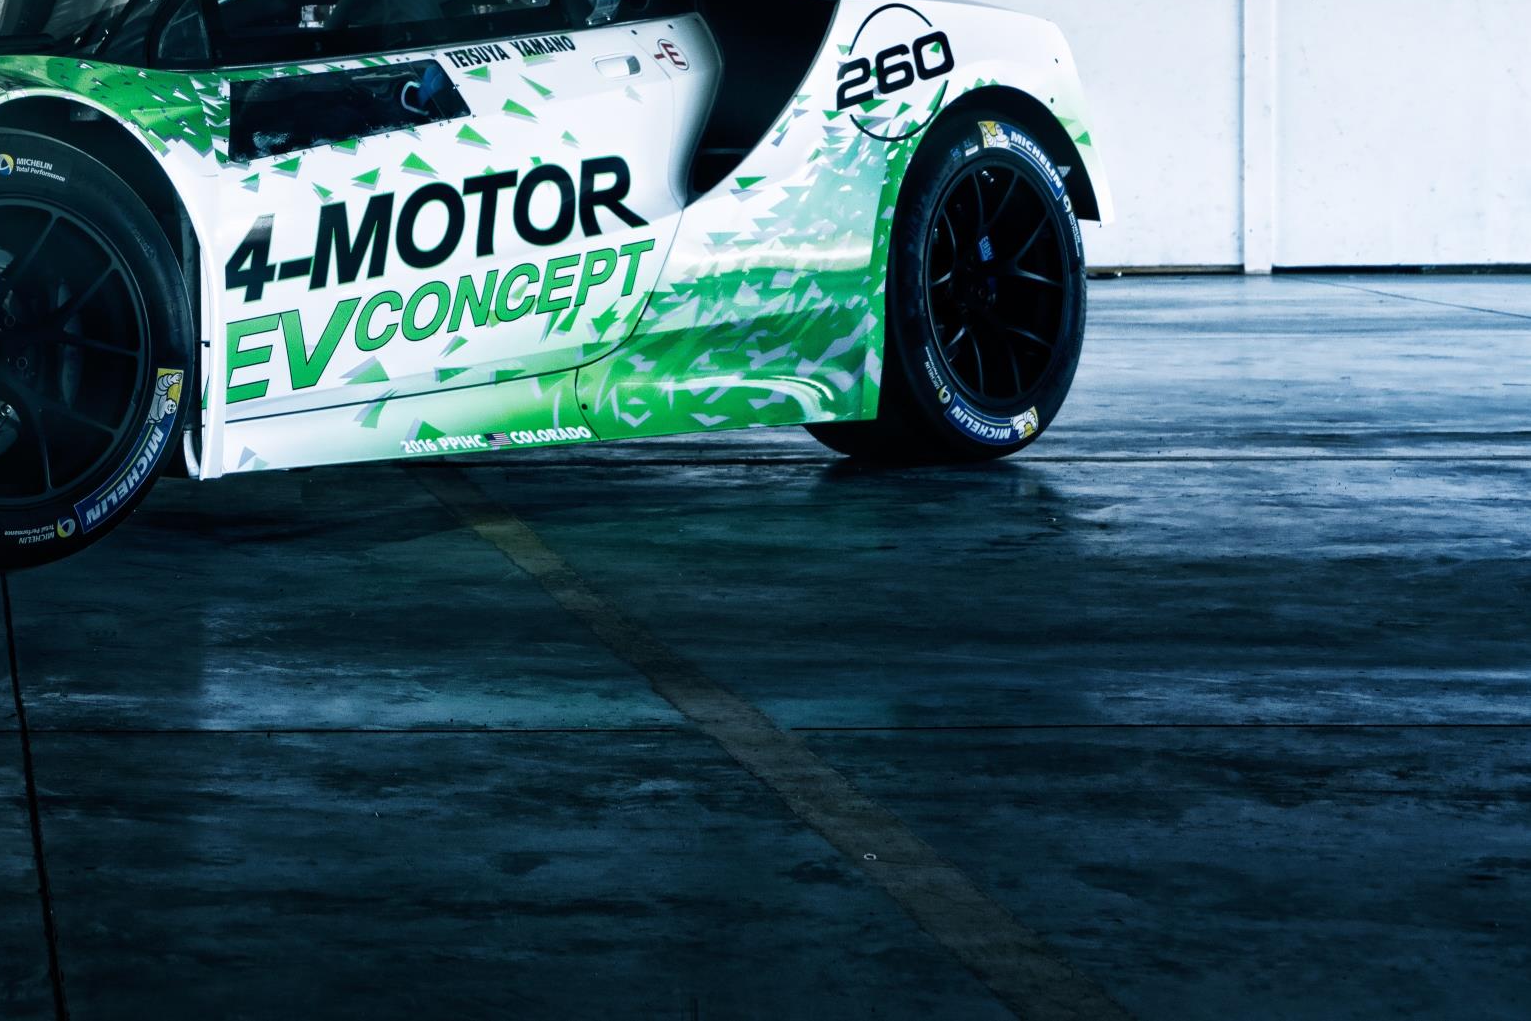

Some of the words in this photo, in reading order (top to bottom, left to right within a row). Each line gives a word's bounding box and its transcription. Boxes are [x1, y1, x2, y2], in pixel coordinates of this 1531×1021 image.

[444, 43, 511, 69] TETSUYA
[509, 34, 576, 58] YAMANO
[837, 31, 954, 111] 260
[15, 165, 31, 174] Total
[30, 167, 66, 183] Performance
[16, 157, 53, 170] MICHELIN
[1010, 131, 1063, 188] MICHELIN
[225, 156, 650, 304] 4-MOTOR
[204, 298, 360, 409] EV
[354, 238, 656, 353] CONCEPT
[400, 437, 438, 454] 2016
[437, 434, 488, 452] PPIHC
[509, 425, 592, 445] COLORADO
[950, 405, 1012, 440] MICHELIN
[86, 425, 165, 525] MICHELIN
[19, 531, 55, 545] MICHELIN
